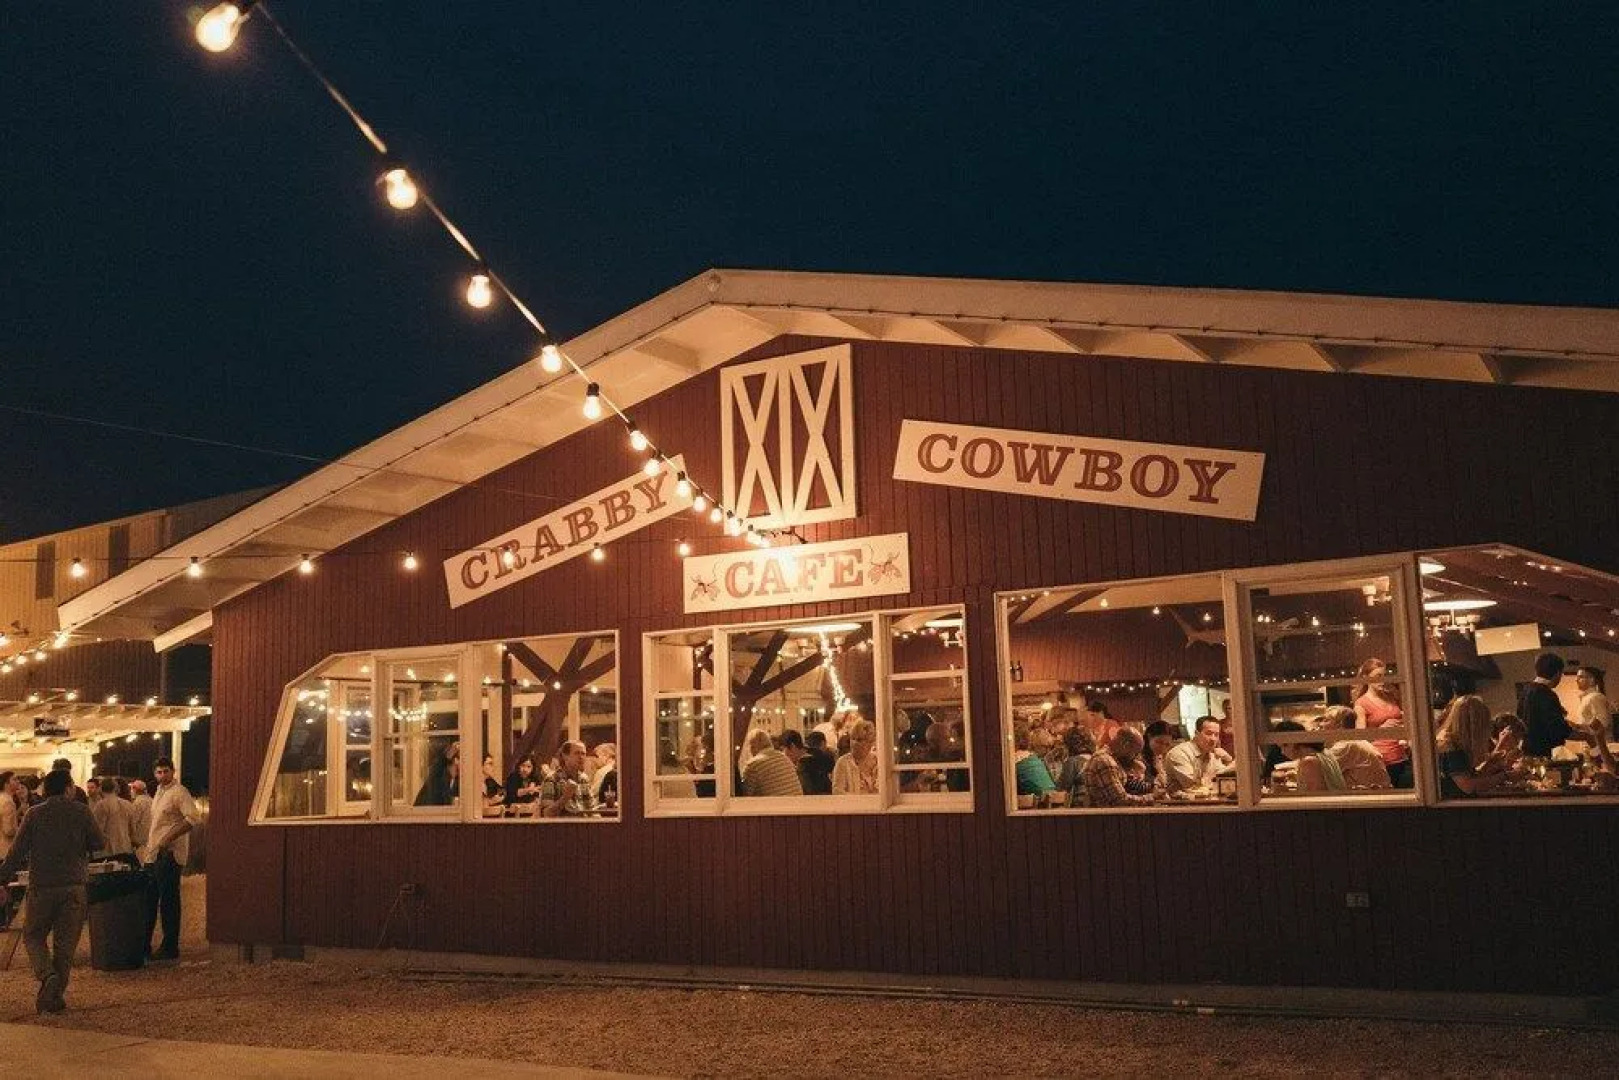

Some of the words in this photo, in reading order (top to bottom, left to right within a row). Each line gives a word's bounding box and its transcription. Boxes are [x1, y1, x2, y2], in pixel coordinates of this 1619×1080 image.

[917, 433, 1236, 504] COWBOY
[462, 472, 668, 589] CRABBY
[725, 549, 864, 598] CAFE
